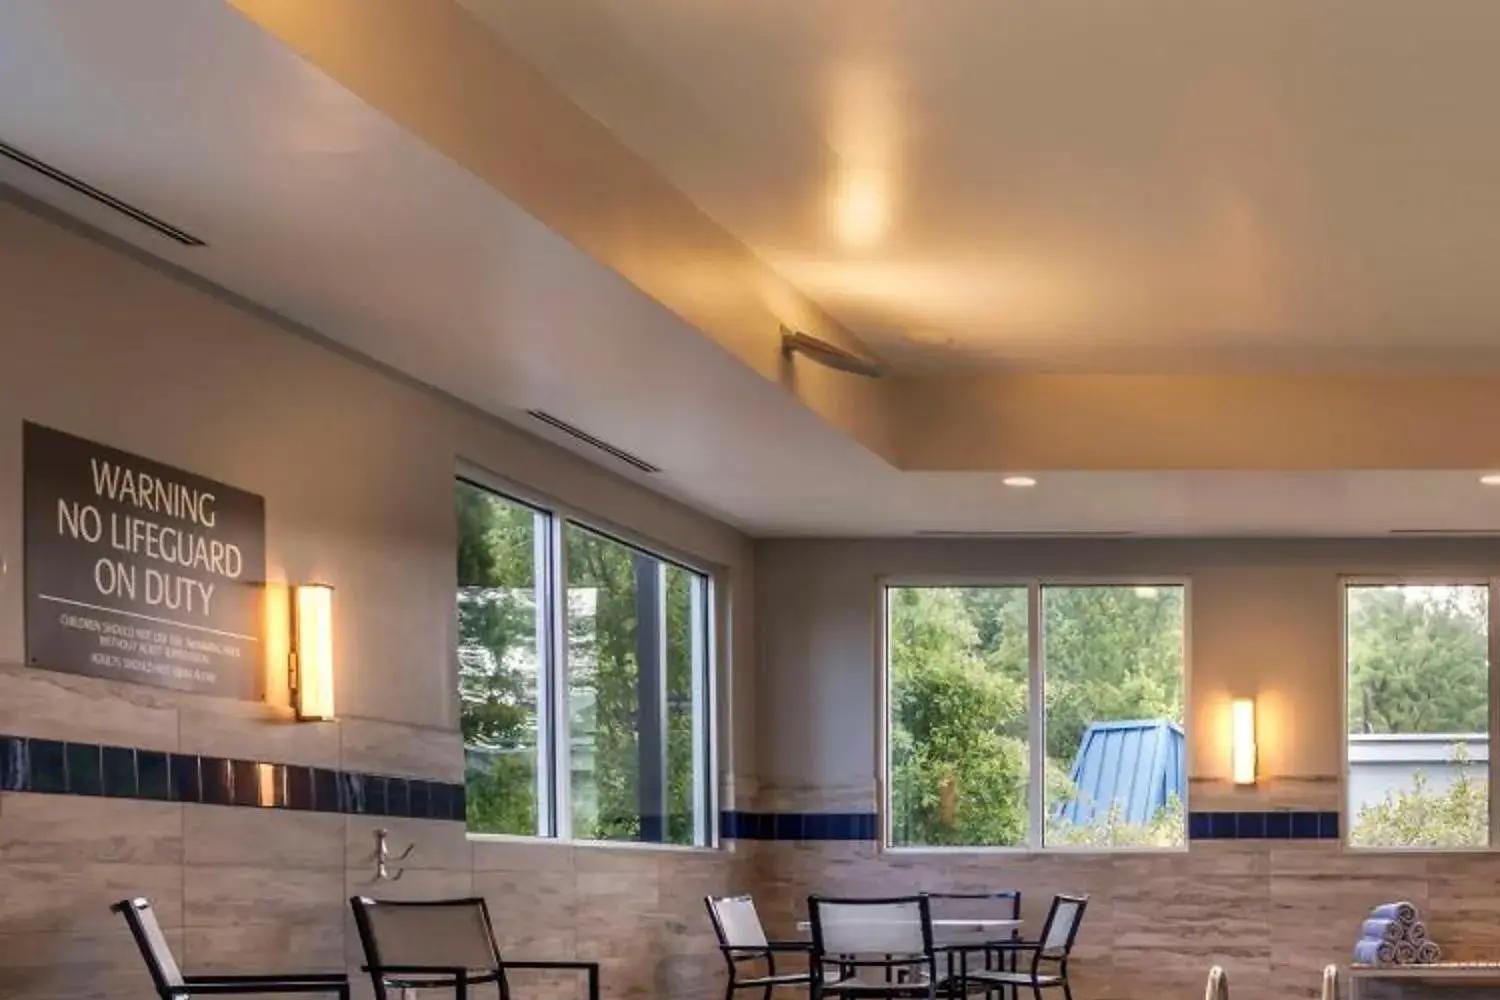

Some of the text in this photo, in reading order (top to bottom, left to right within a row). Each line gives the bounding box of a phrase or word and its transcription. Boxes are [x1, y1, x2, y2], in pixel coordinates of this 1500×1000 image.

[90, 457, 216, 528] WARNING
[56, 498, 243, 579] NO LIFEGUARD
[94, 557, 216, 617] ON DUTY
